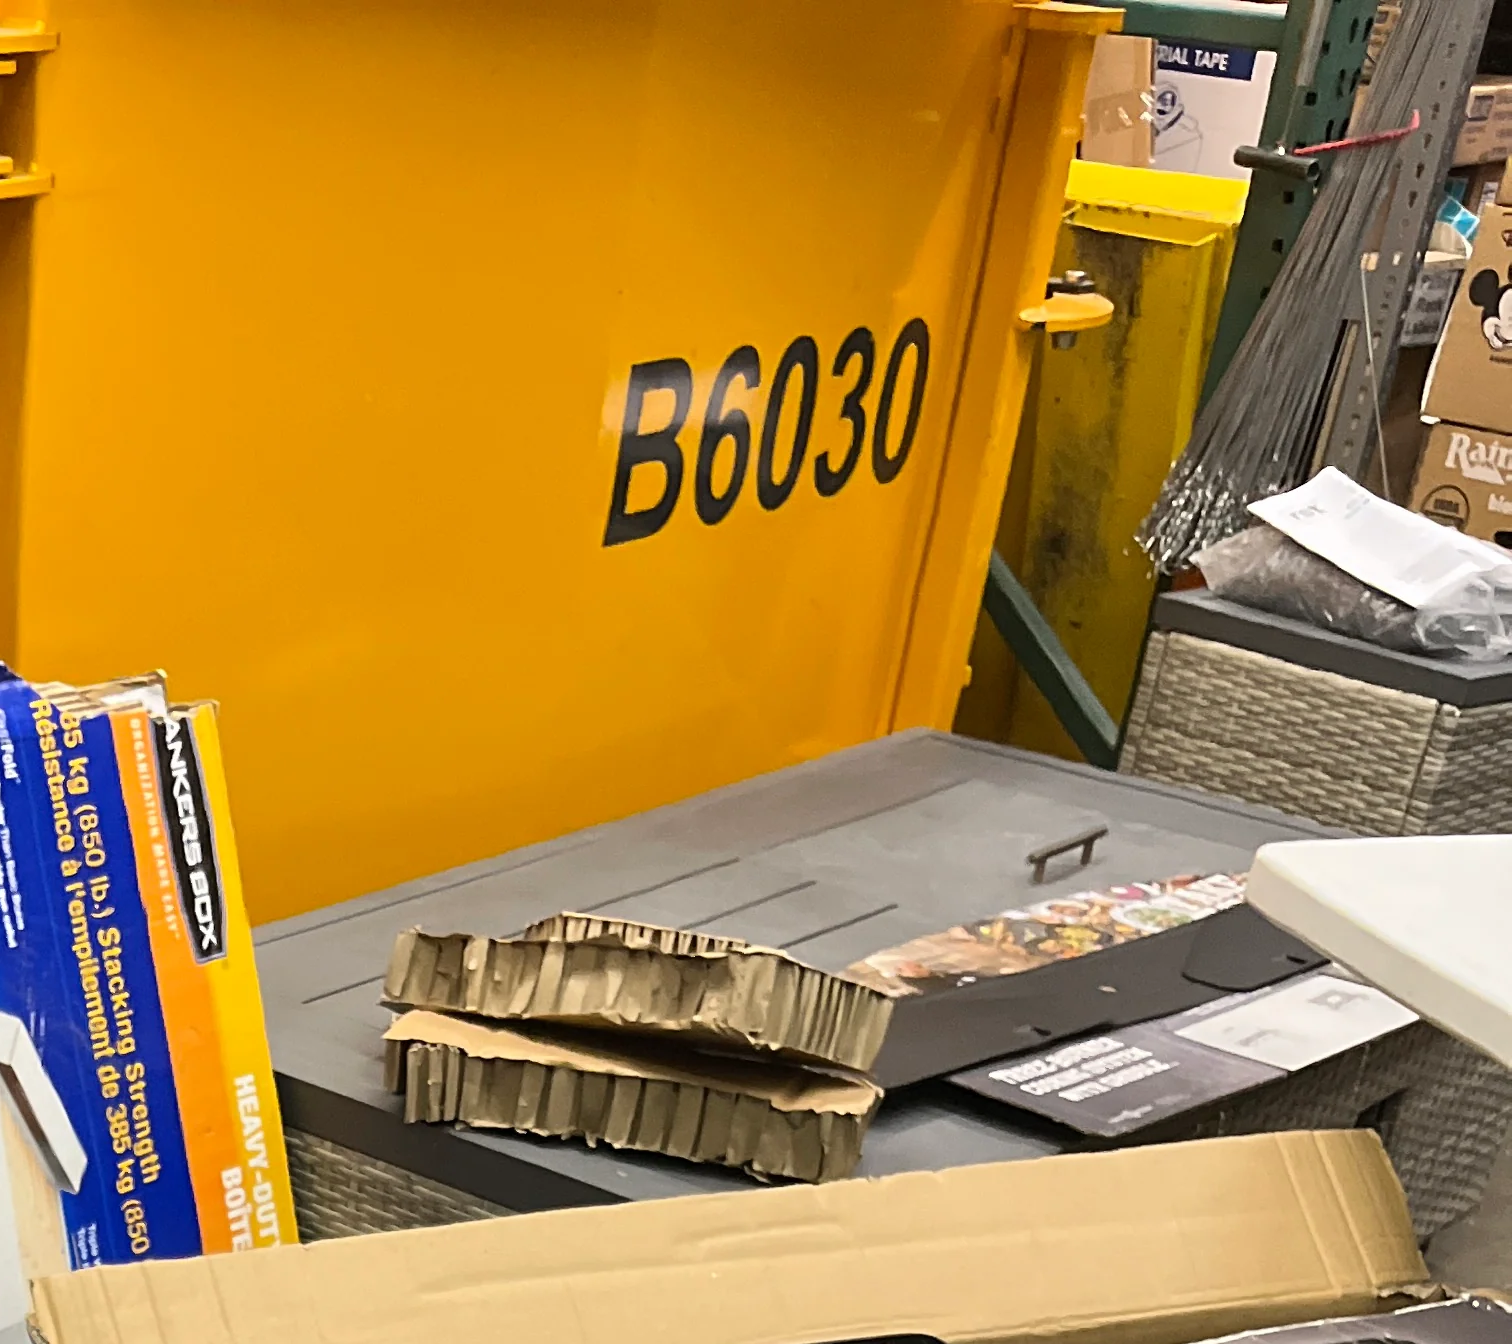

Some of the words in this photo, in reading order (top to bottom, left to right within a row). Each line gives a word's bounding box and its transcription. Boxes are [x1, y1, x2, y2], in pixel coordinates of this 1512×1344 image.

[1193, 49, 1228, 70] TAPE
[601, 317, 930, 548] B6030
[60, 708, 83, 748] 85
[30, 698, 74, 851] Résistance
[66, 757, 89, 795] kg
[74, 804, 106, 867] (850
[160, 718, 202, 866] ANKERS
[190, 870, 217, 949] BOX
[59, 857, 83, 877] à
[89, 876, 115, 918] lb.)
[67, 883, 114, 1058] l'empilement
[96, 928, 135, 1054] Stacking
[98, 1065, 120, 1098] de
[106, 1104, 132, 1154] 385
[118, 1063, 160, 1183] Strength
[116, 1159, 134, 1194] kg
[77, 1228, 88, 1260] Triple
[88, 1224, 98, 1257] Triple
[122, 1200, 150, 1254] (850
